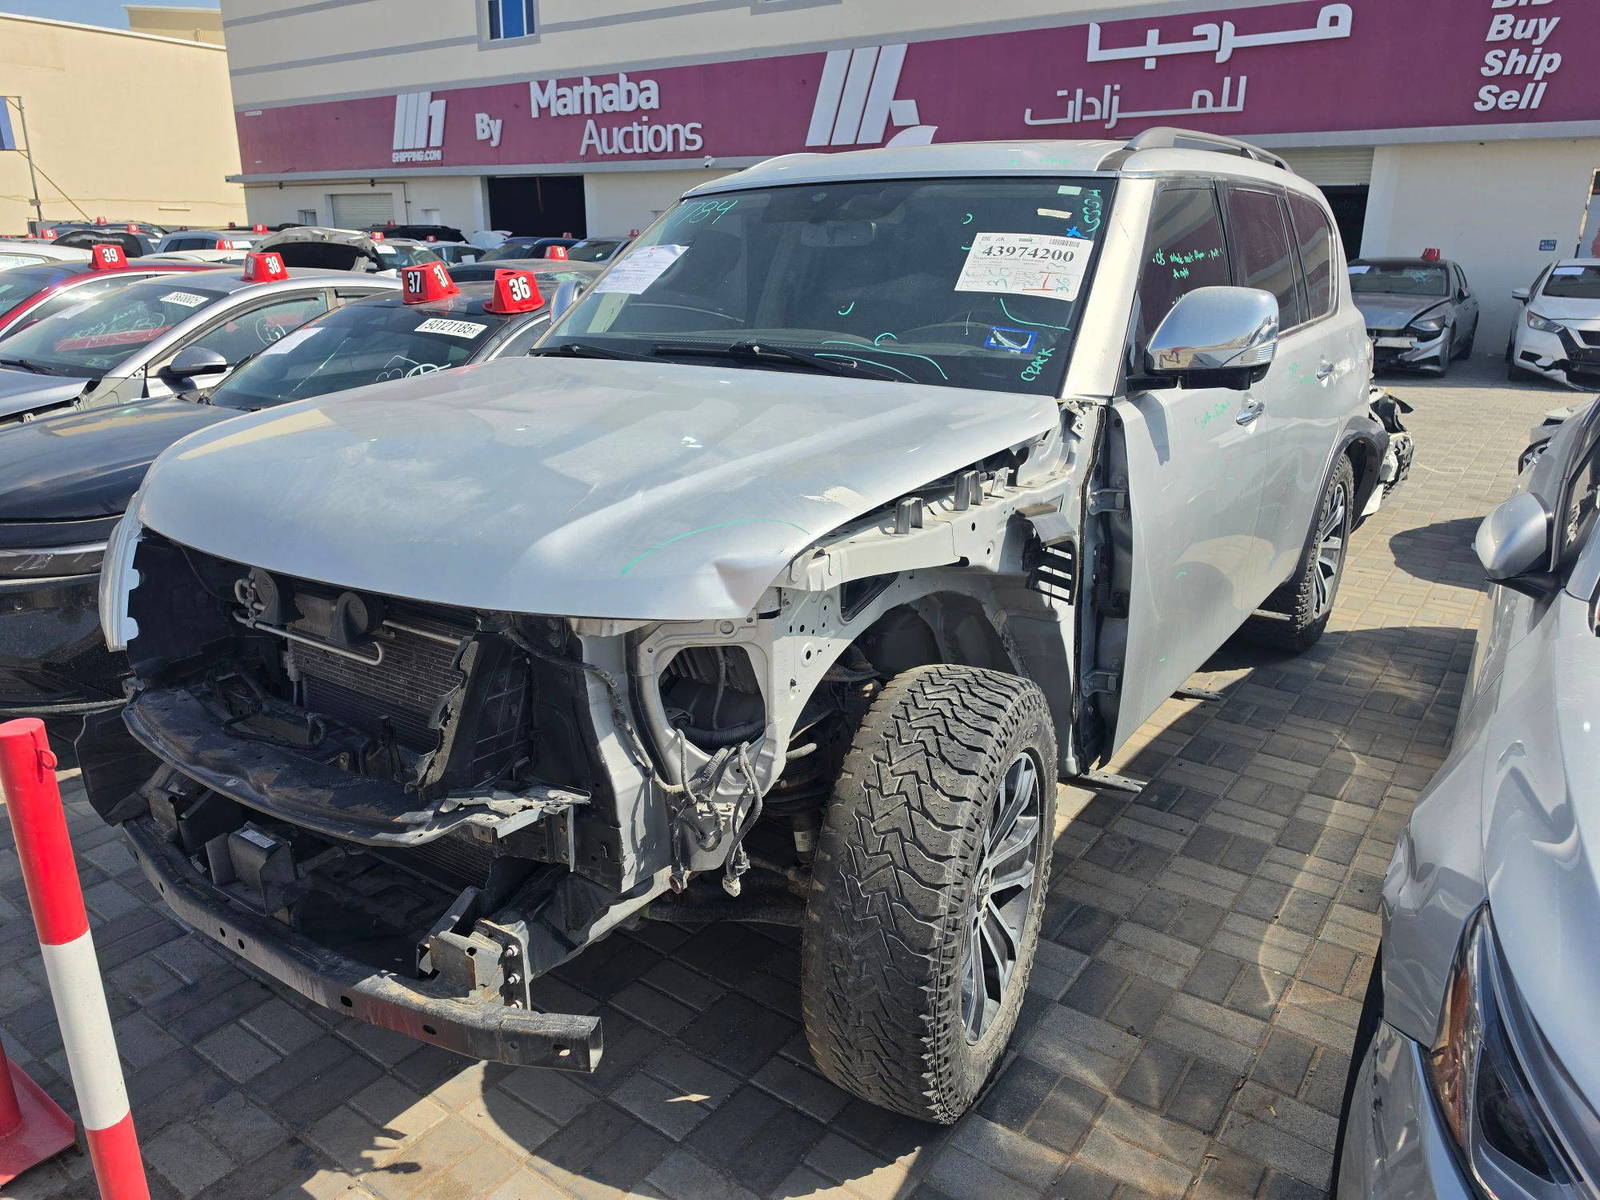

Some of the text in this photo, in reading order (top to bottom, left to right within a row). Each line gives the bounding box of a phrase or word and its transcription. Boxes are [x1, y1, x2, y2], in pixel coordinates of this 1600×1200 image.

[1086, 3, 1353, 69] مرحبا
[1485, 14, 1560, 45] Buy
[1481, 48, 1562, 80] Ship
[530, 73, 660, 118] Marhaba
[1024, 75, 1247, 129] للمزادات
[1473, 82, 1548, 111] Sell
[475, 112, 503, 147] By
[579, 115, 703, 156] Auctions
[102, 247, 119, 263] 39
[265, 255, 281, 275] 38
[982, 244, 1075, 263] 43974200
[407, 271, 422, 293] 37
[433, 264, 449, 288] 37
[508, 276, 532, 301] 36
[1020, 347, 1056, 382] CRACK
